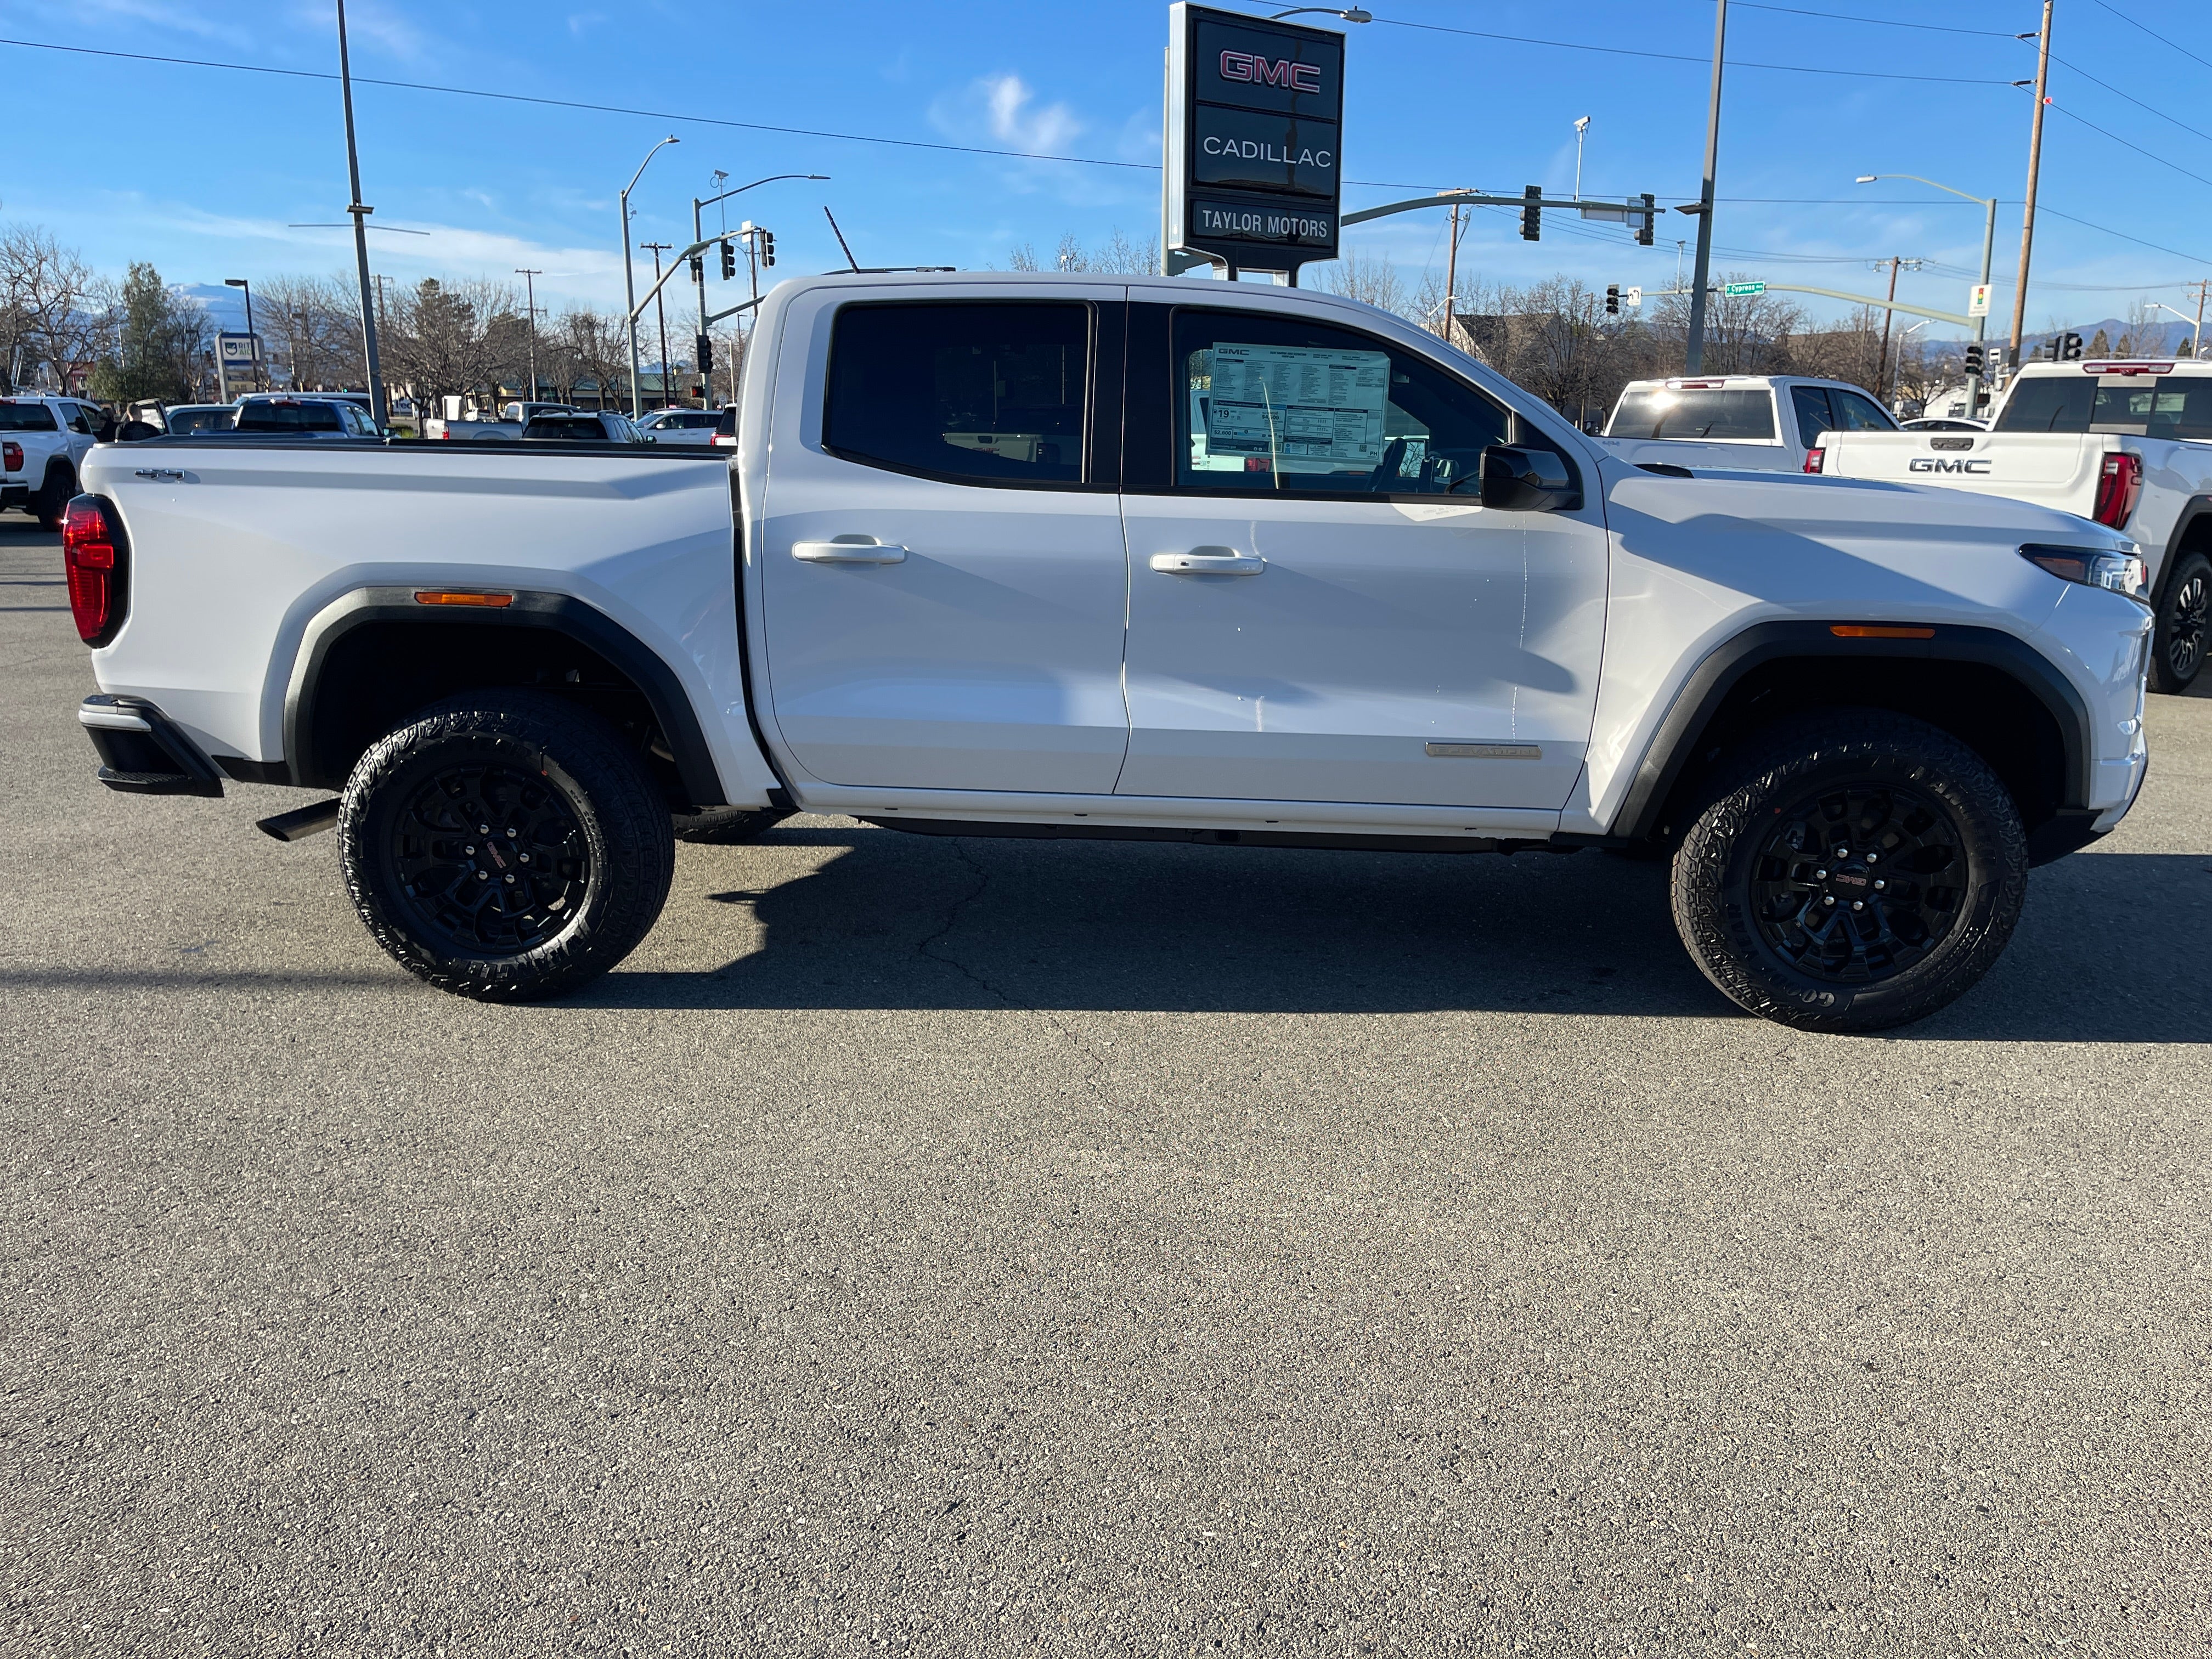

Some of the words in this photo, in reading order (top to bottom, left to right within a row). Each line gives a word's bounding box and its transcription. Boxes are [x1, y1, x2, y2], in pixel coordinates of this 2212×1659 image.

[1220, 50, 1321, 93] GMC
[1203, 136, 1331, 168] CADILLAC
[1203, 210, 1262, 232] TAYLOR
[1267, 216, 1328, 238] MOTORS
[1731, 285, 1755, 293] Cypress
[1218, 410, 1229, 418] 19
[1909, 458, 1991, 474] GMC
[1433, 746, 1532, 755] ELEVATION
[487, 841, 506, 868] GMC
[1836, 873, 1867, 886] GMC
